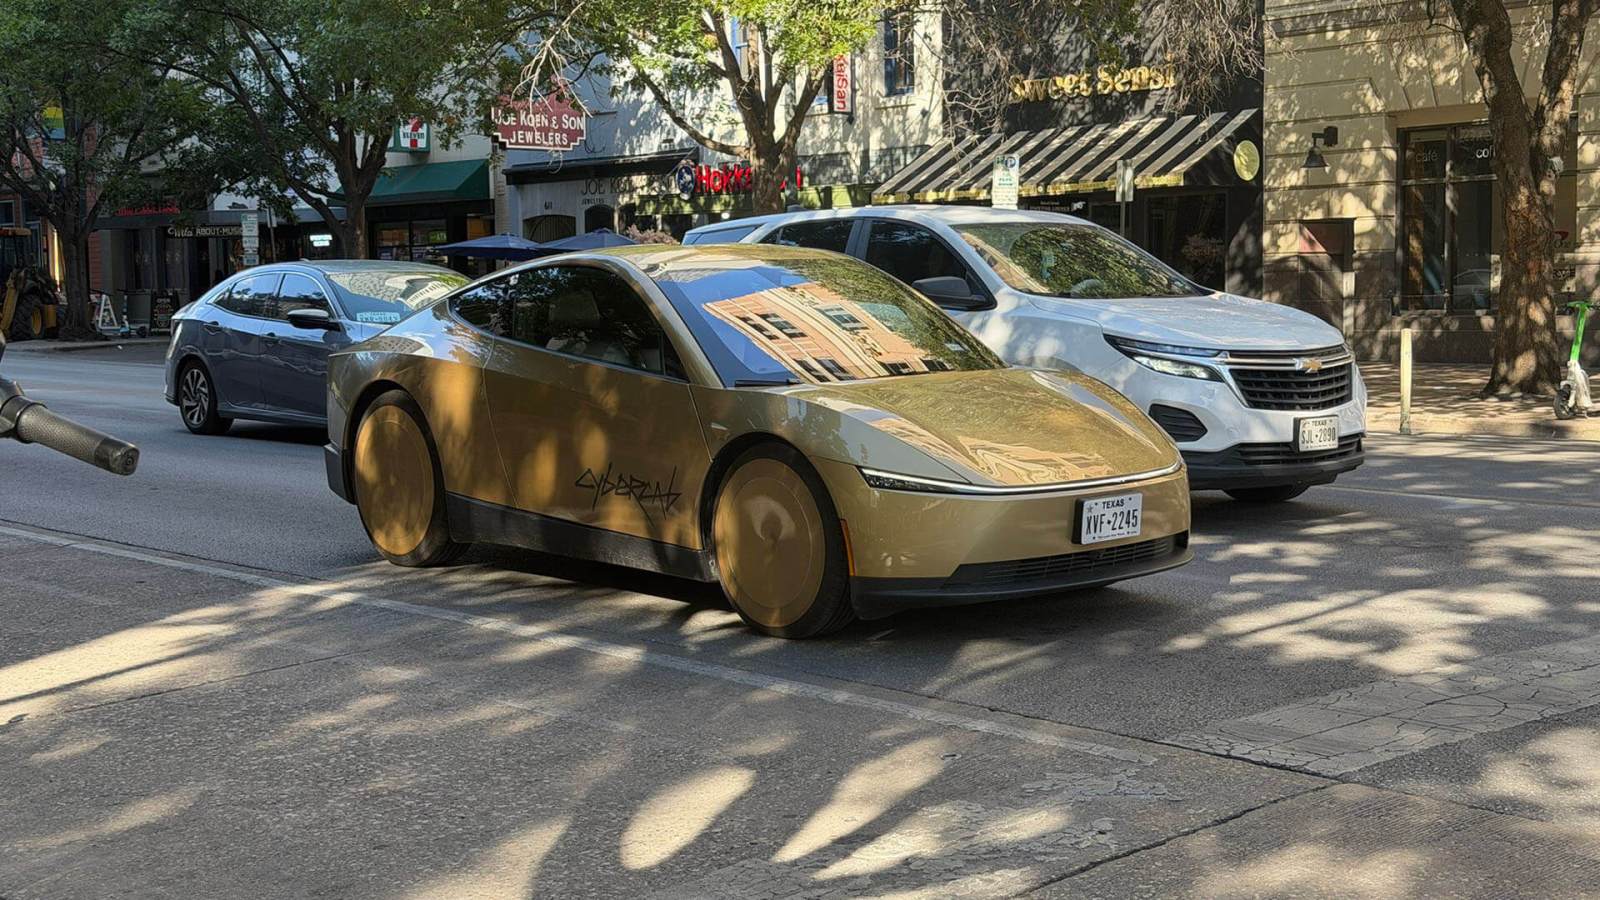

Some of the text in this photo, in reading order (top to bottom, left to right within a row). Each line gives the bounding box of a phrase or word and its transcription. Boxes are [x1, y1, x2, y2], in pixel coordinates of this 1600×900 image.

[1008, 72, 1092, 103] Sweet
[561, 113, 584, 131] SON
[509, 130, 569, 146] JEWELERS
[1102, 498, 1125, 509] TEXAS
